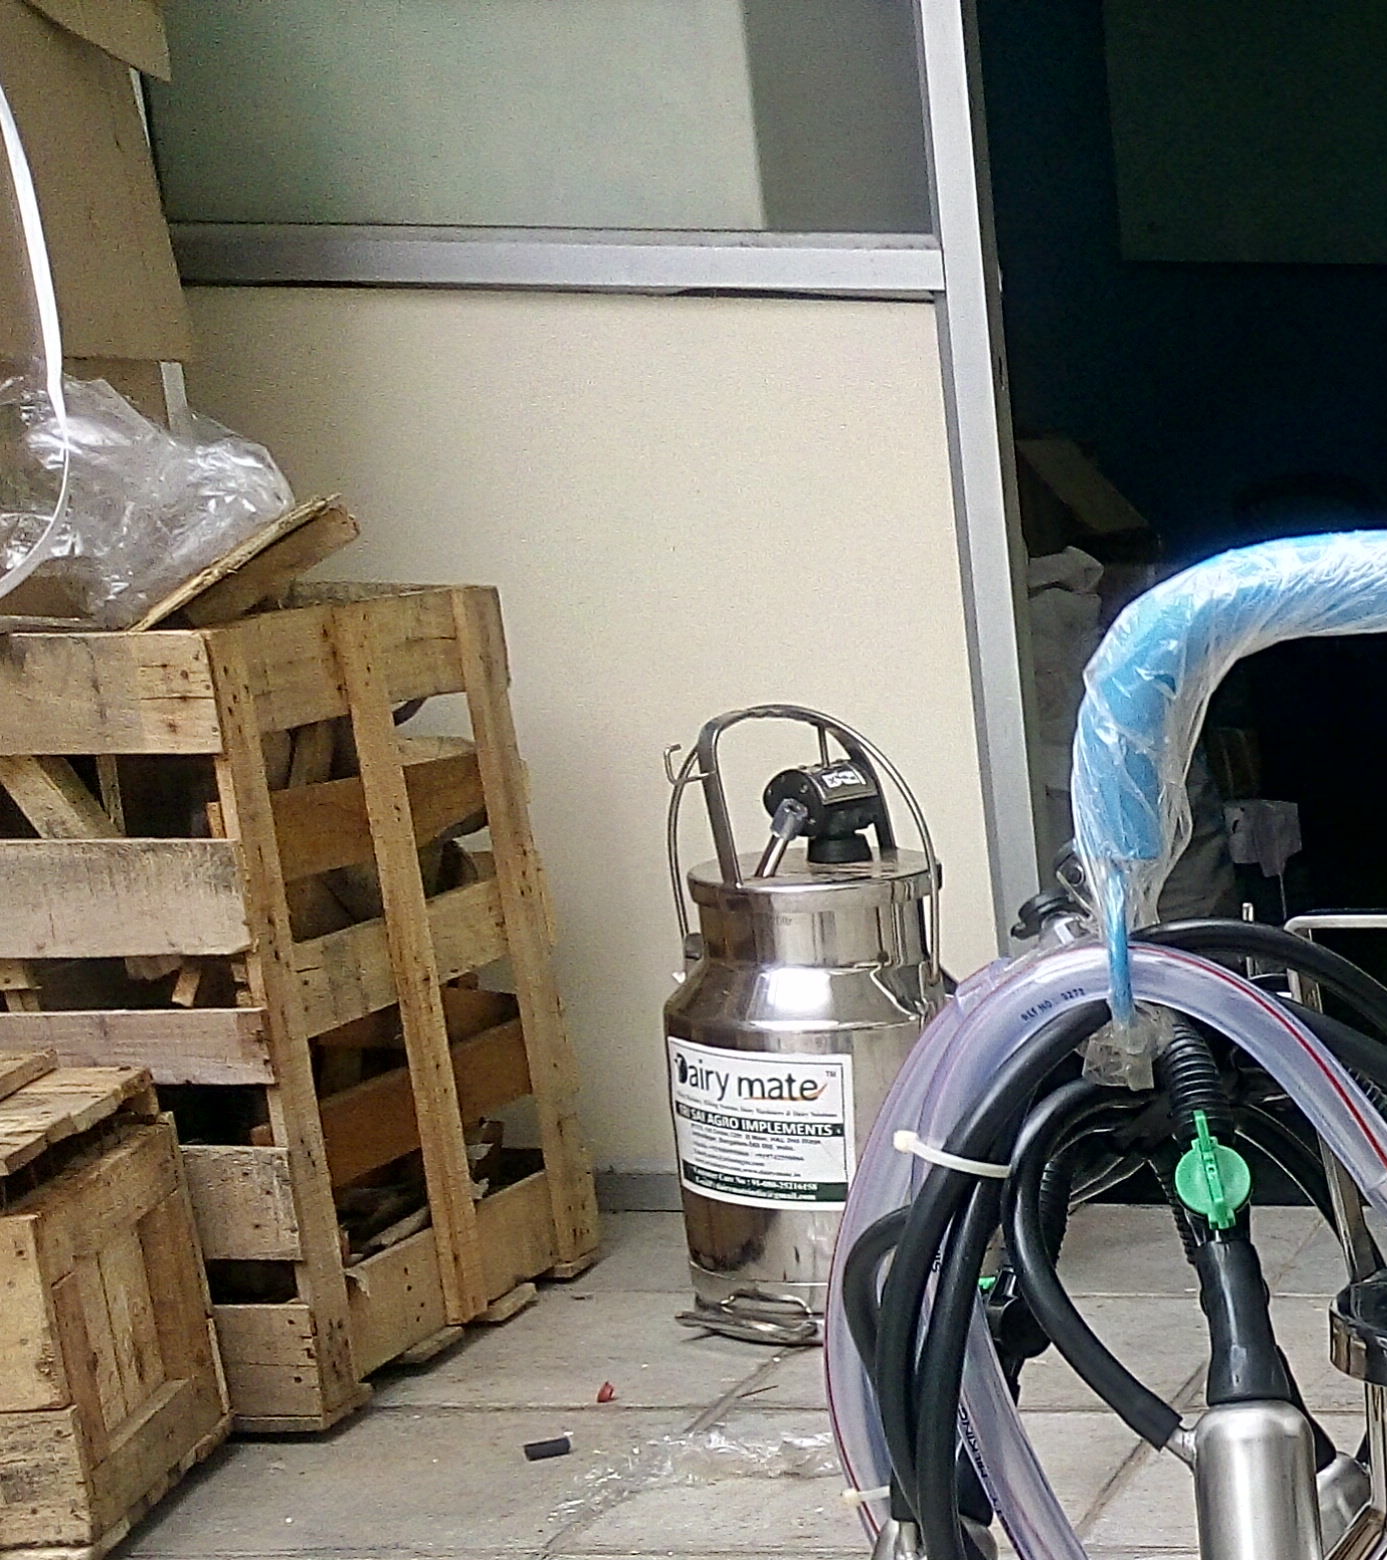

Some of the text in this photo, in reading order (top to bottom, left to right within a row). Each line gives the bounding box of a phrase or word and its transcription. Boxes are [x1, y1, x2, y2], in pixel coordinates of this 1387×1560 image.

[737, 1073, 819, 1101] mate
[707, 1113, 738, 1130] AGRO
[741, 1119, 833, 1137] IMPLEMENTS
